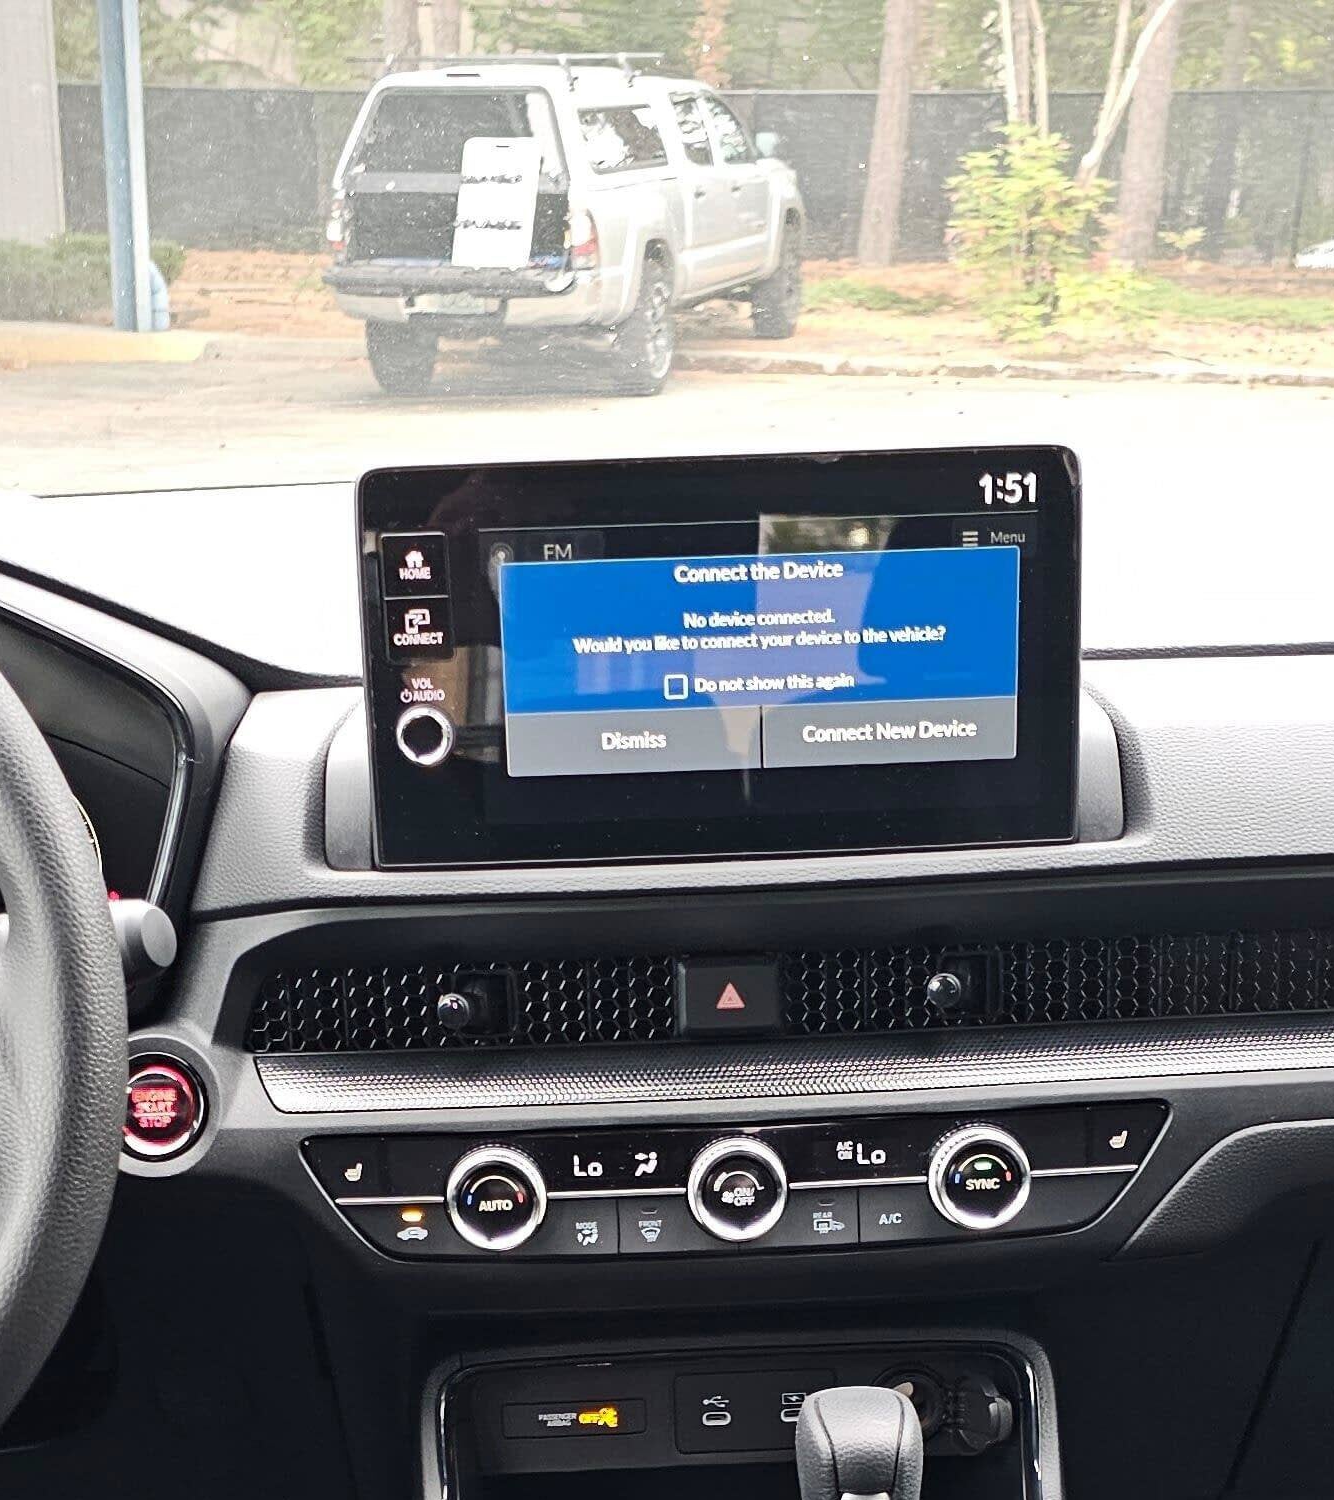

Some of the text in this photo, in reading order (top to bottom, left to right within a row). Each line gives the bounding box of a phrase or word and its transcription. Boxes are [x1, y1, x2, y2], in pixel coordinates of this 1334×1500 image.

[978, 472, 1037, 505] 1:51
[990, 531, 1026, 544] Menu
[543, 544, 572, 560] FM
[399, 566, 431, 580] HOME
[674, 560, 844, 583] Connect the Device
[683, 608, 835, 629] No device connected.
[393, 632, 443, 646] CONNECT
[573, 625, 946, 654] Would you like to connect your device to the vehicle?
[411, 677, 434, 690] VOL
[695, 673, 855, 692] Do not show this again
[412, 689, 445, 702] AUDIO
[802, 720, 977, 743] Connect New Device
[601, 731, 667, 750] Dismiss
[131, 1089, 177, 1103] ENGINE
[135, 1101, 174, 1113] START
[139, 1117, 172, 1128] STOP
[836, 1141, 854, 1151] A/C
[857, 1143, 886, 1165] Lo
[574, 1154, 603, 1177] Lo
[965, 1178, 1001, 1191] SYNC
[478, 1200, 513, 1212] AUTO
[733, 1195, 755, 1207] OFF
[575, 1221, 598, 1230] MODE
[638, 1219, 662, 1228] FRONT
[879, 1214, 902, 1225] A/C
